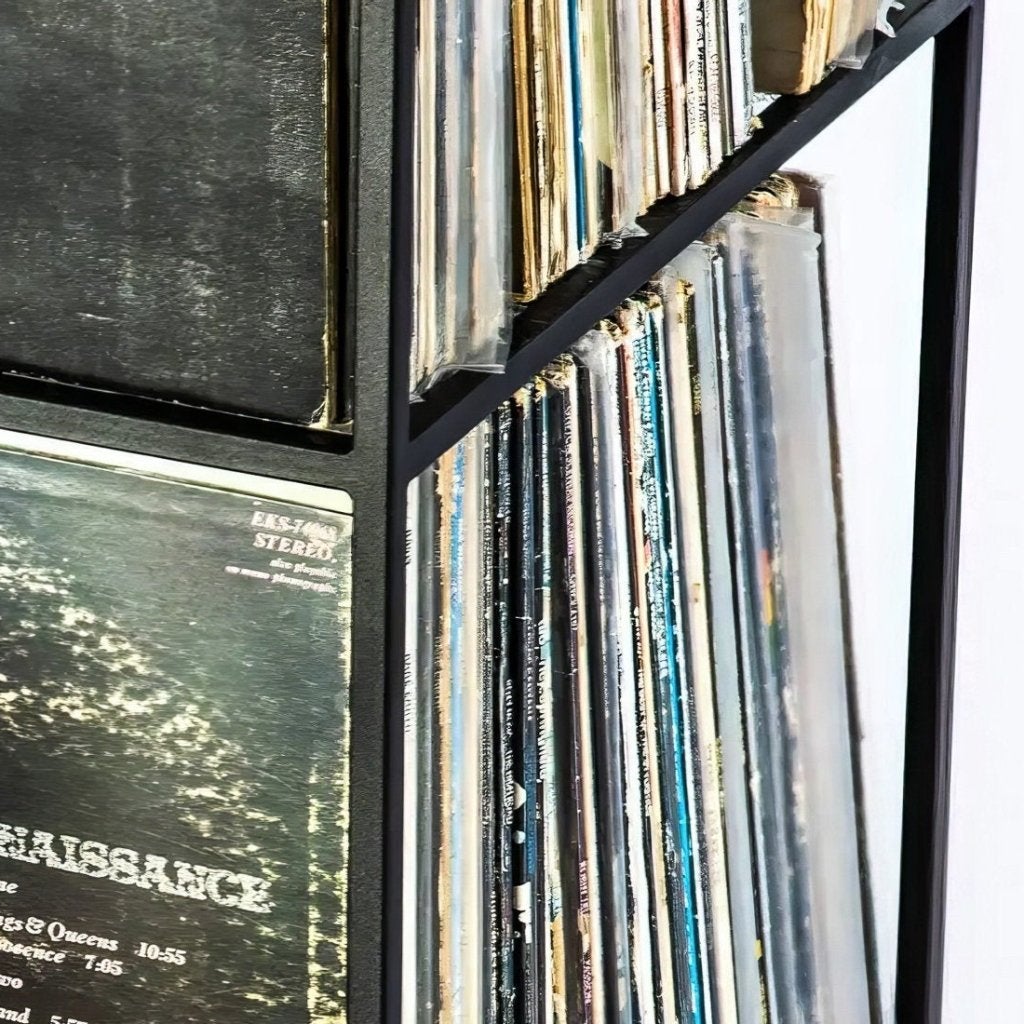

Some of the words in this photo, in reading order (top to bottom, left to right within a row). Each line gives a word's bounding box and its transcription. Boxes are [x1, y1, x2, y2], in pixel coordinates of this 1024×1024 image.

[25, 917, 45, 934] &
[48, 922, 119, 951] Queens
[137, 942, 187, 965] 10:55
